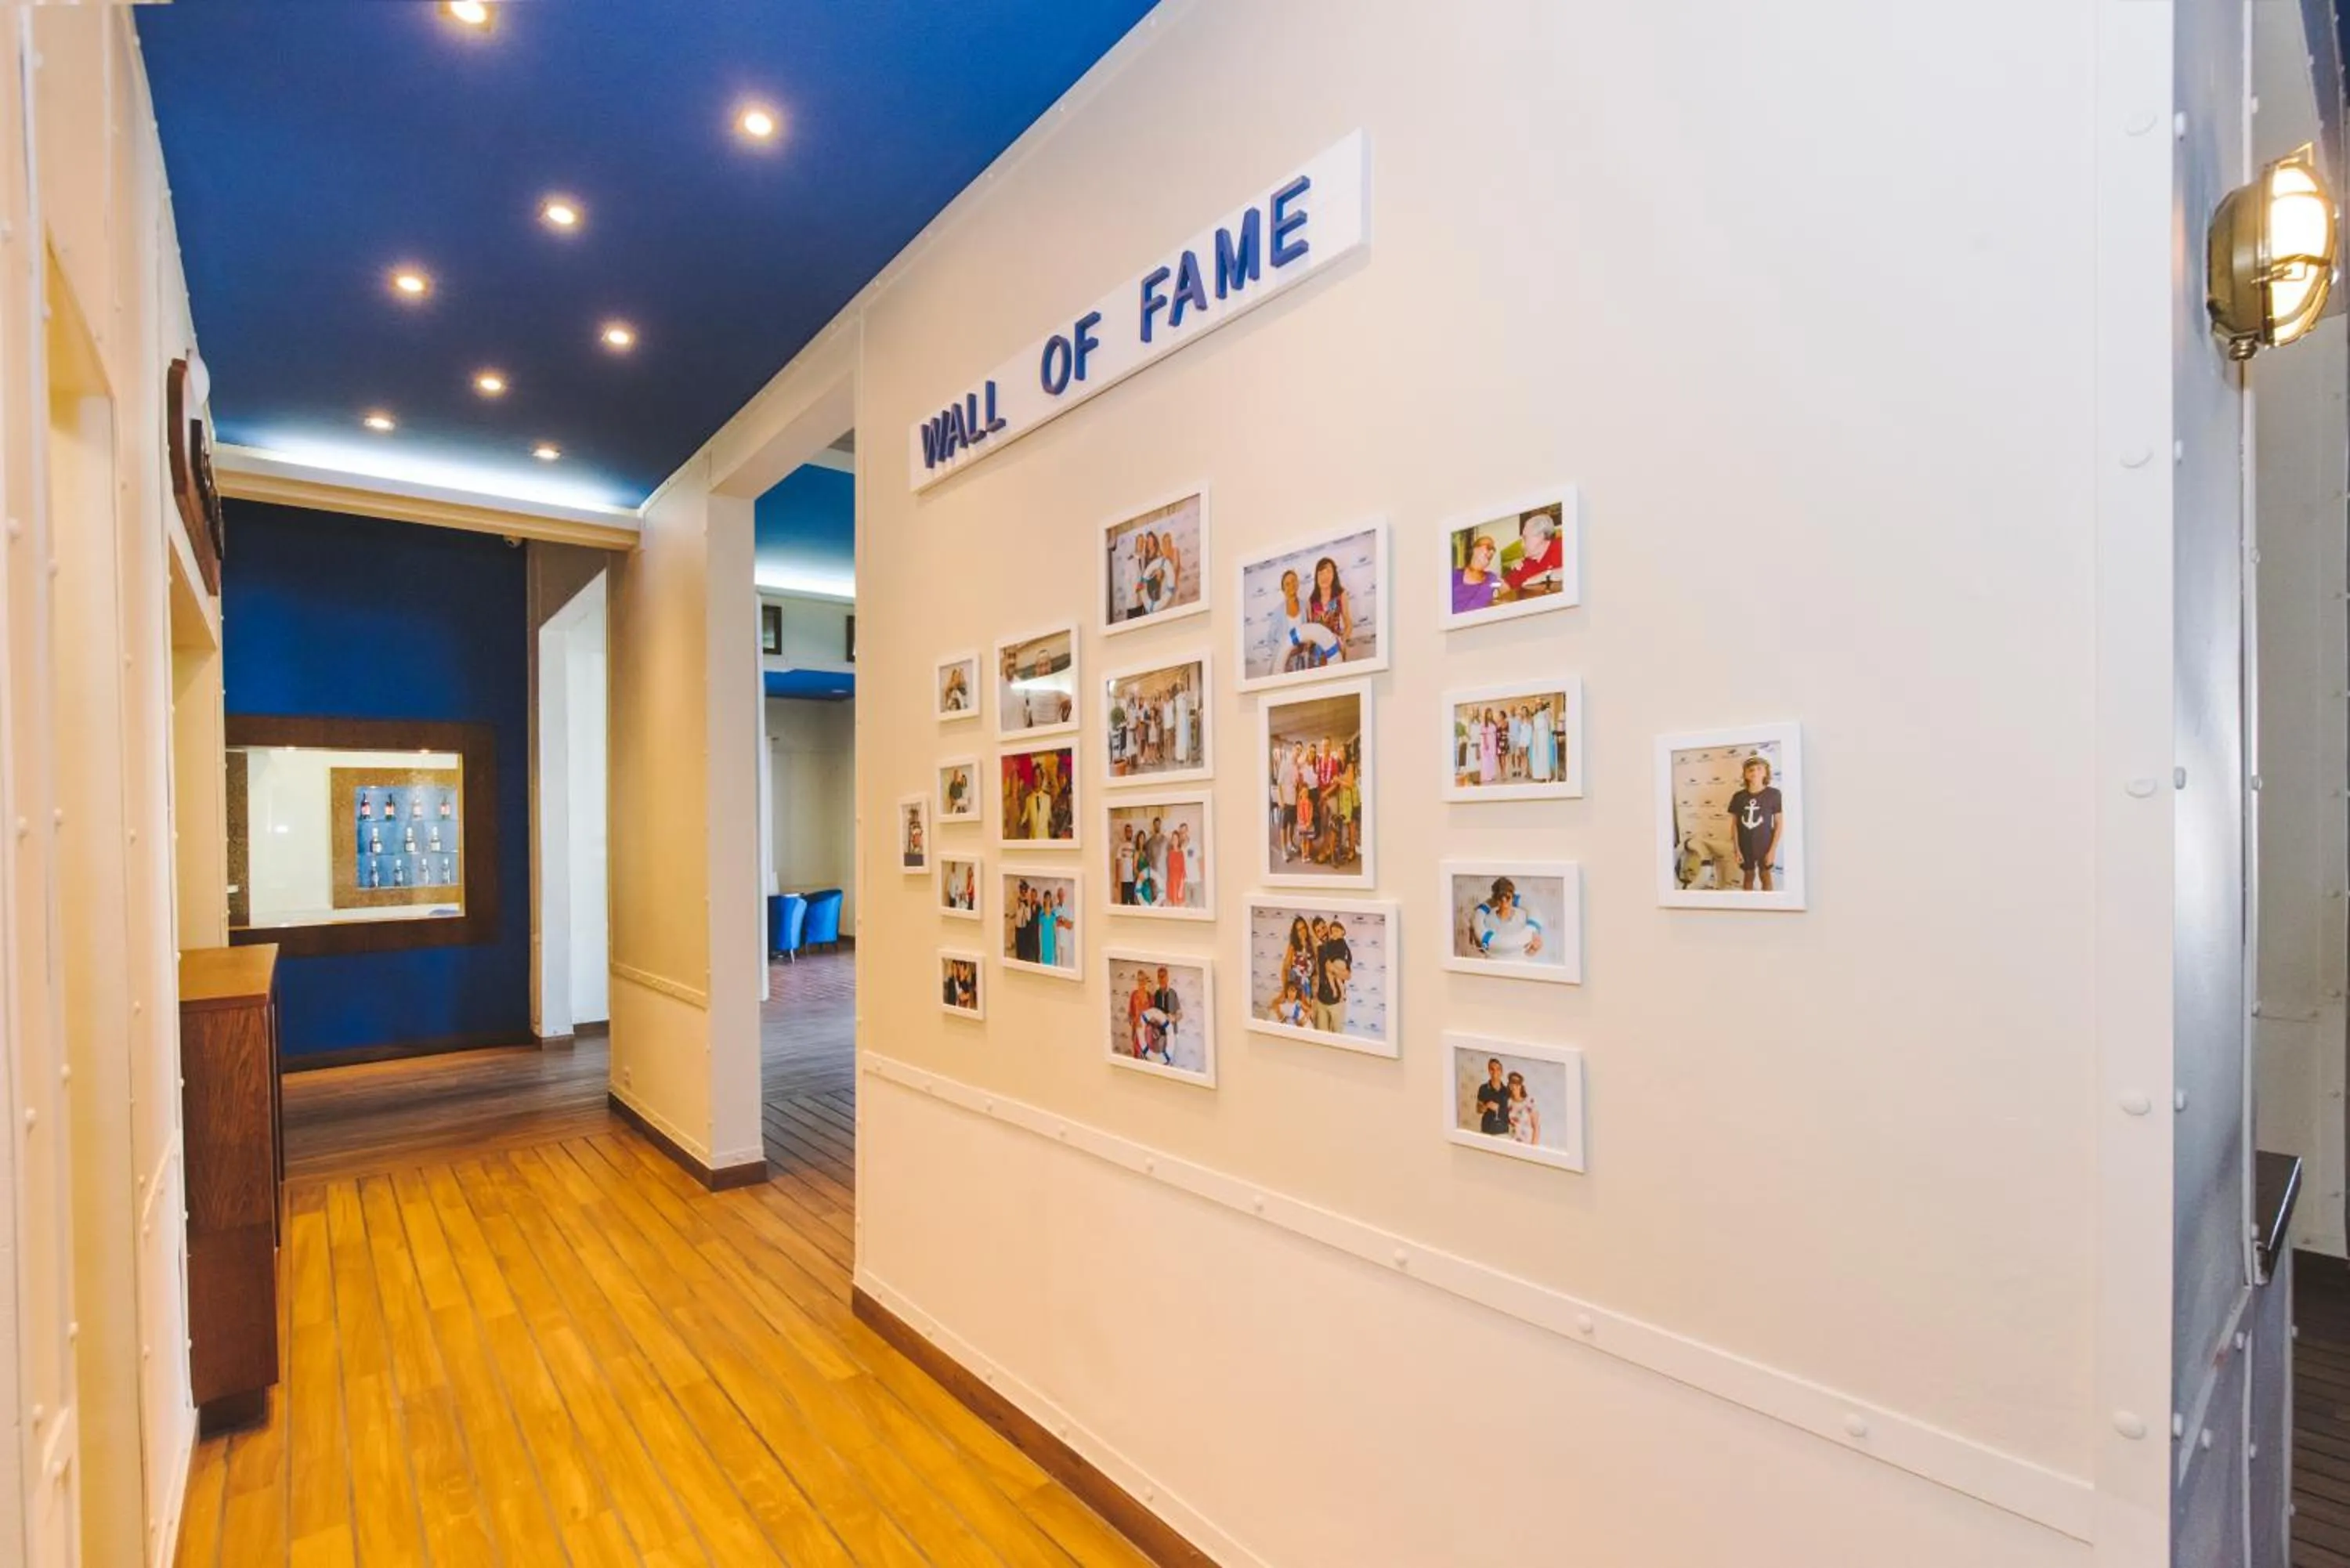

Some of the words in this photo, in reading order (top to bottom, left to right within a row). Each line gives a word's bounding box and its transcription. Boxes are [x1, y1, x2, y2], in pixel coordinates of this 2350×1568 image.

[921, 380, 1007, 469] WALL
[1040, 311, 1101, 396] OF
[1140, 175, 1311, 343] FAME
